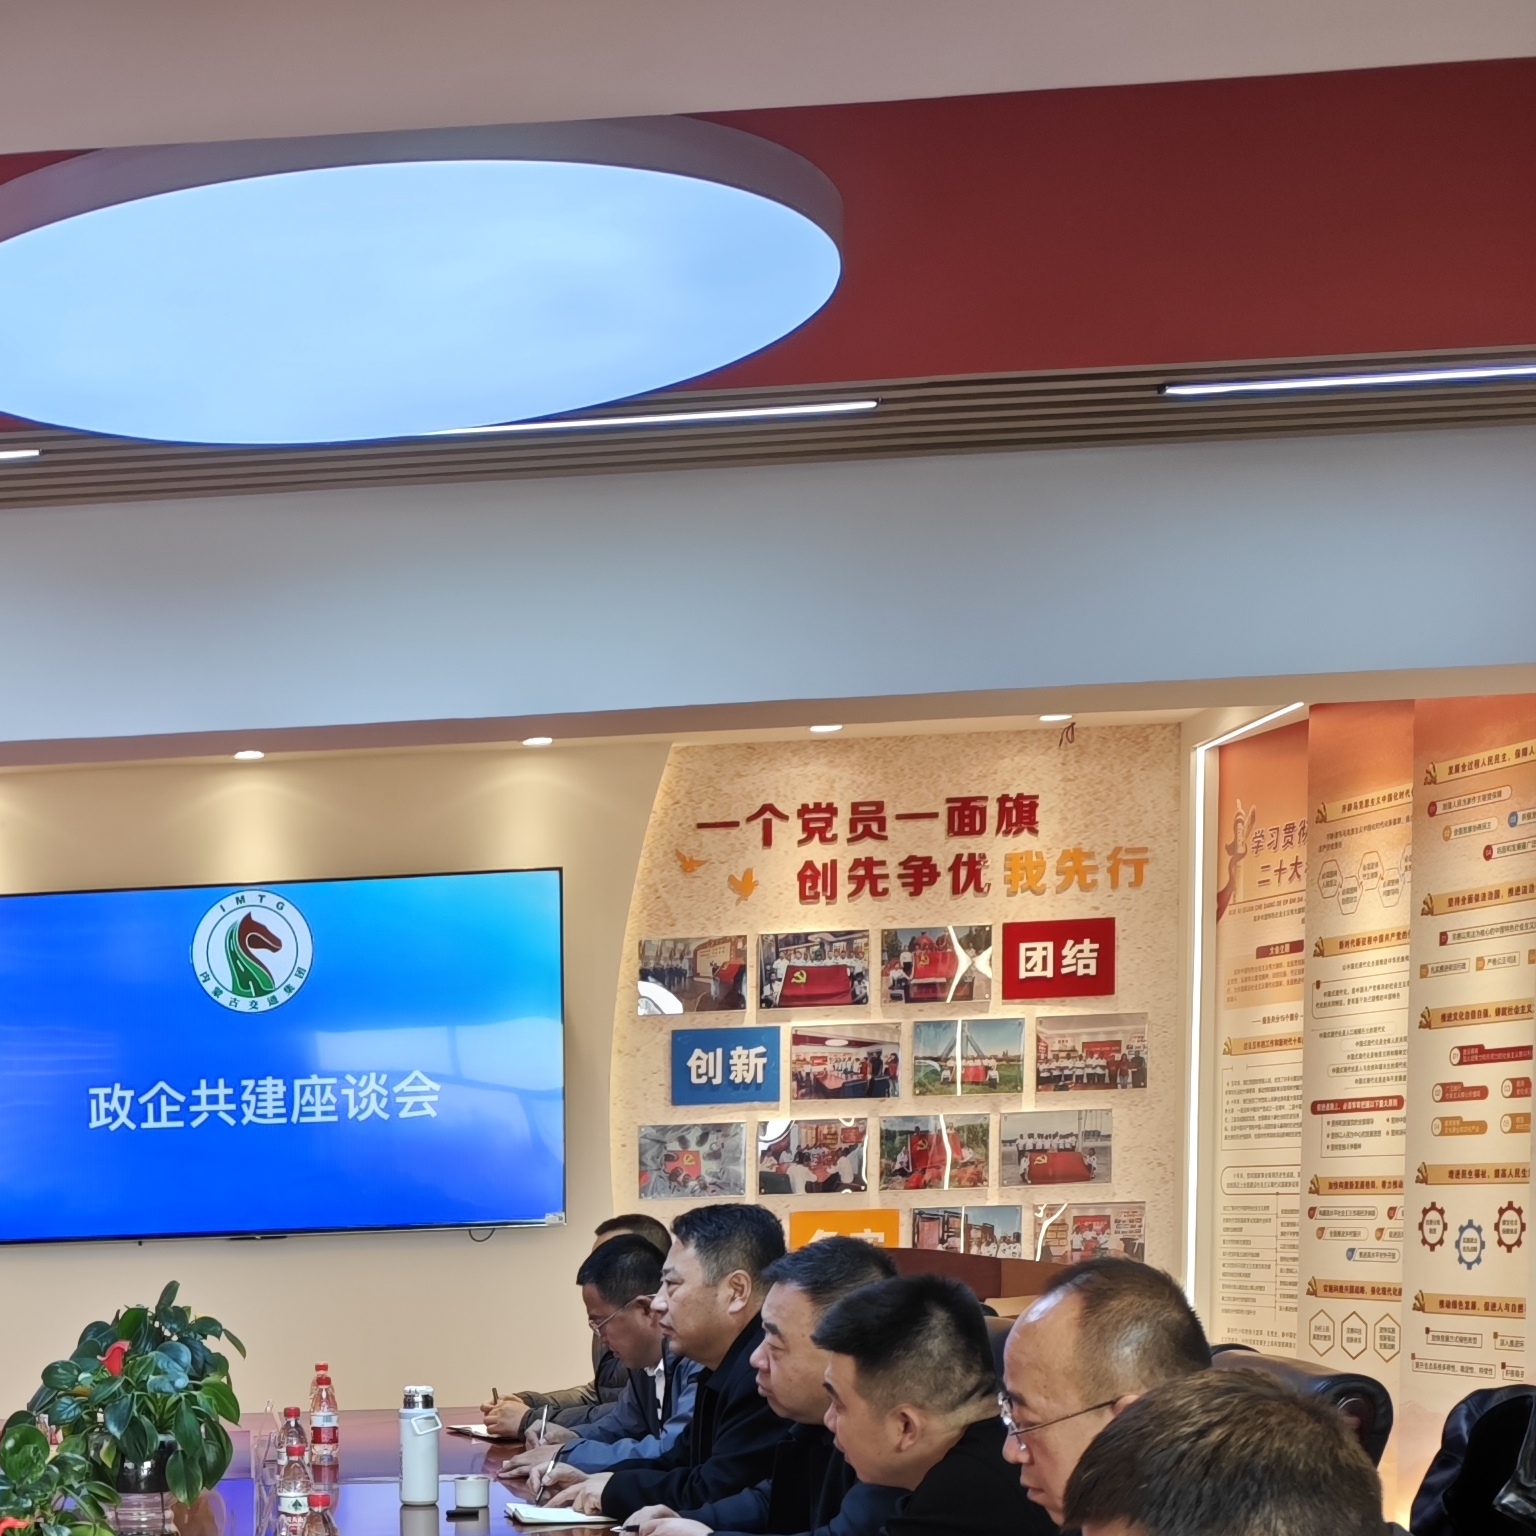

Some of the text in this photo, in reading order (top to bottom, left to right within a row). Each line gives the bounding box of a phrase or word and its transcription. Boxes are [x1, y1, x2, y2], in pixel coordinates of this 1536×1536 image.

[696, 793, 1040, 848] 一个党员一面旗
[1341, 789, 1413, 814] 开辟马克思主义中国化时代
[1258, 855, 1307, 887] 二十大
[1018, 939, 1100, 980] 团结
[199, 966, 307, 1011] 内蒙古交通集团
[686, 1045, 768, 1086] 创新
[88, 1069, 441, 1133] 政企共建座谈会
[1439, 1299, 1526, 1314] 推动绿色发展，促进人与自然
